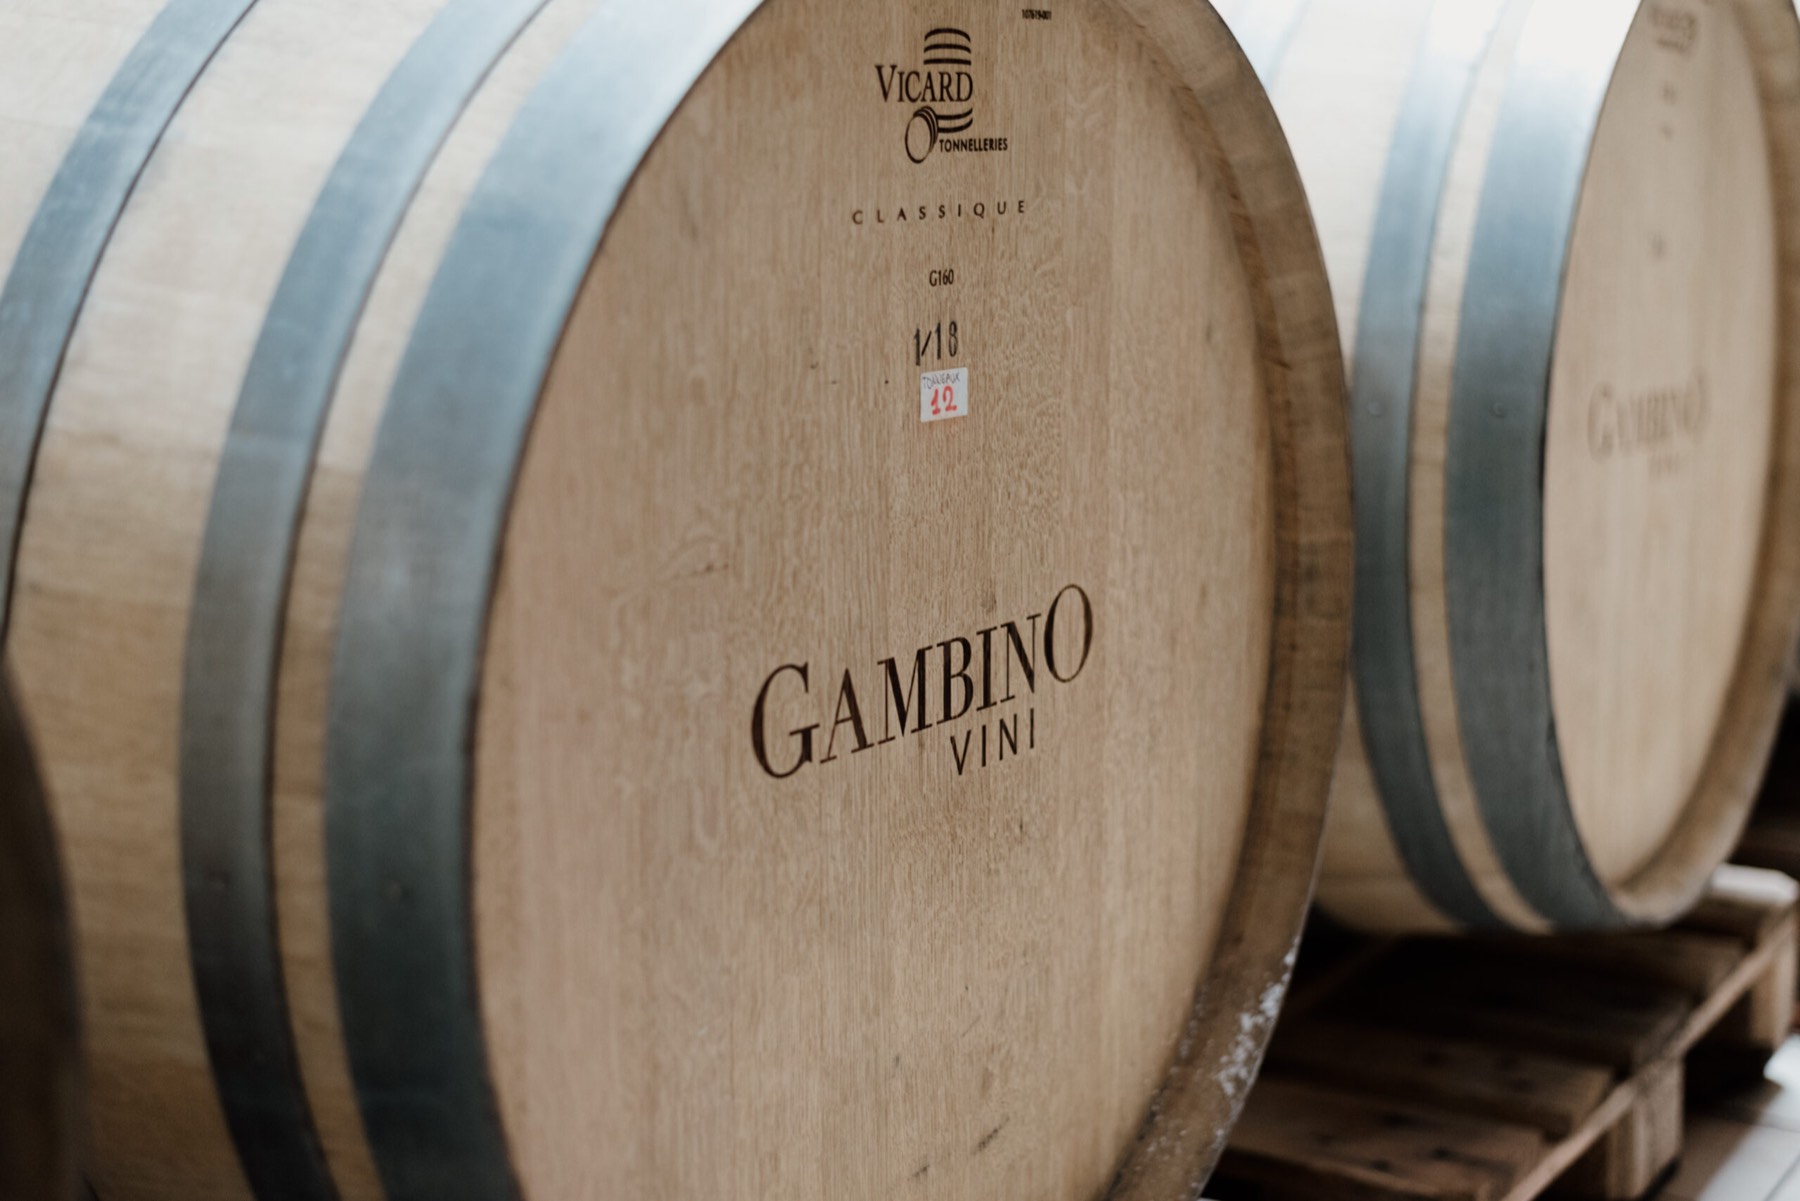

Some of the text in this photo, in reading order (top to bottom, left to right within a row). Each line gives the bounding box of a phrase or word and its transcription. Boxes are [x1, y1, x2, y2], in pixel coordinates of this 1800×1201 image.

[875, 64, 973, 102] VICARD
[939, 138, 1008, 152] TONNELLERIES
[852, 200, 1025, 225] CLASSIQUE
[929, 269, 954, 287] G160
[930, 385, 958, 415] 12
[751, 584, 1093, 778] GAMBINO
[950, 707, 1035, 775] VINI
